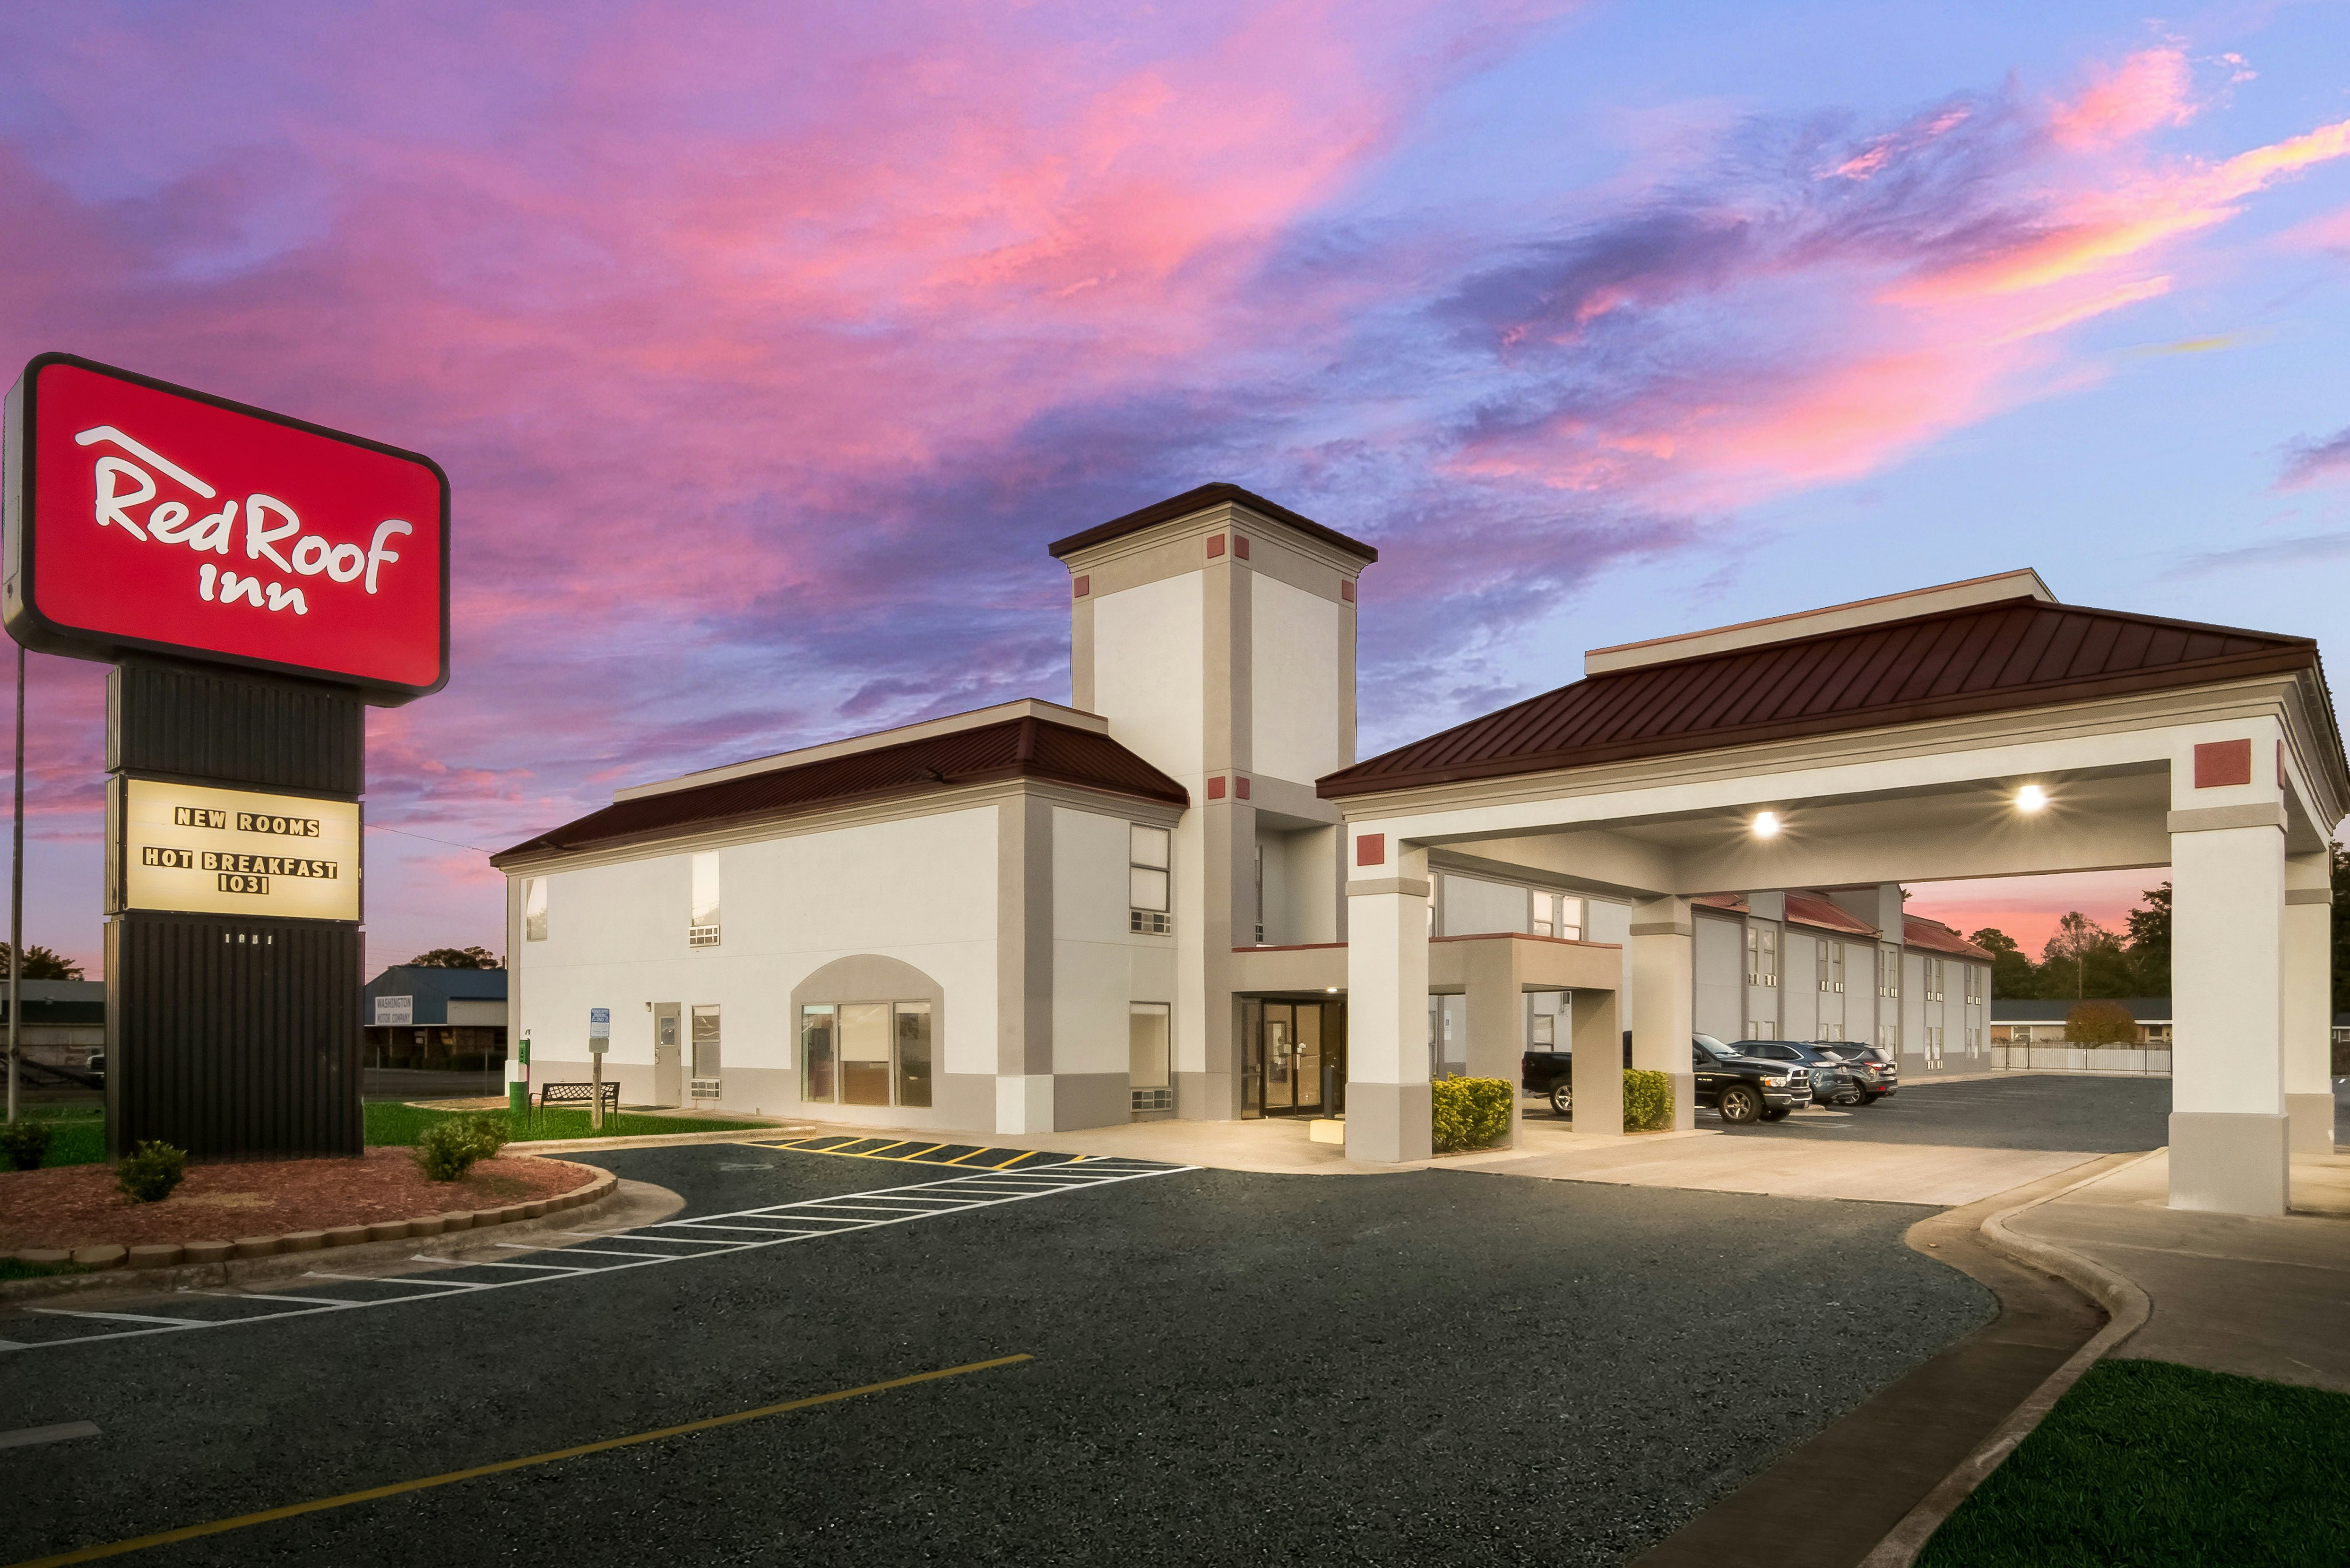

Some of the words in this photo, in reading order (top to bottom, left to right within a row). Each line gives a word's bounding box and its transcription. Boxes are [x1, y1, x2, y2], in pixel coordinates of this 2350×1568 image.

[95, 456, 237, 555] Red
[246, 493, 413, 594] Roof
[199, 563, 308, 615] Inn
[177, 808, 225, 828] NEW
[240, 814, 319, 837] ROOMS
[146, 848, 192, 868] HOT
[204, 853, 337, 879] BREAKFAST
[220, 875, 268, 894] 1031
[377, 998, 411, 1008] WASHINGTON
